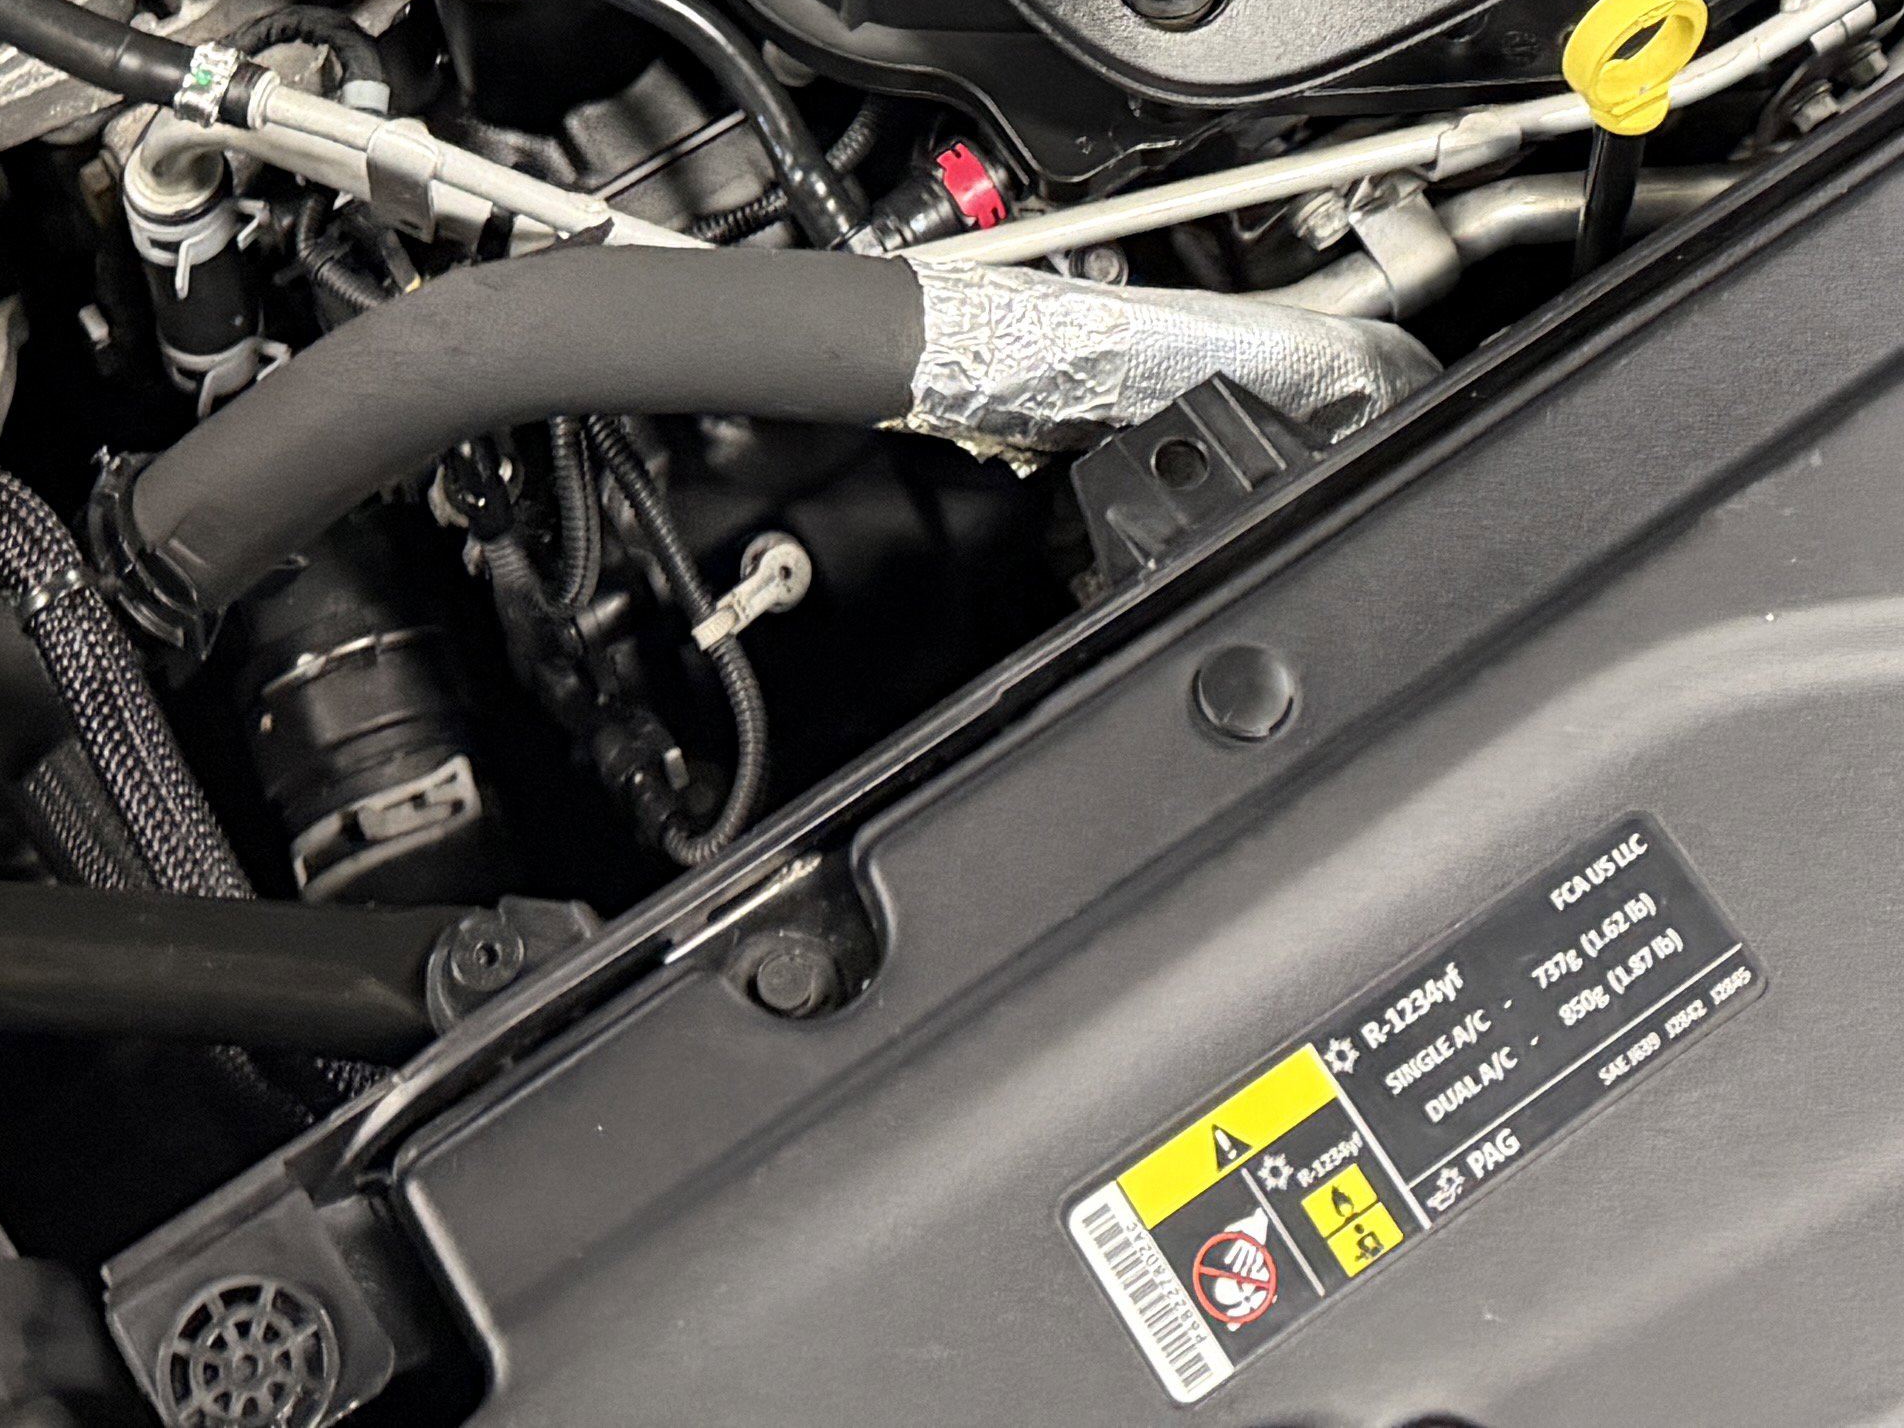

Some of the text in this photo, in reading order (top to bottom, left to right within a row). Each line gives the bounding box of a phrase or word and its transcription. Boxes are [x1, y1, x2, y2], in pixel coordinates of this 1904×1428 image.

[1549, 832, 1649, 912] FCA US LLC
[1360, 961, 1464, 1050] R-1234yf
[1384, 1033, 1456, 1096] SINGLE
[1451, 1008, 1492, 1050] A/C
[1531, 948, 1584, 990] 737g
[1579, 910, 1631, 958] (1.62
[1623, 891, 1657, 924] lb)
[1423, 1074, 1484, 1124] DUAL
[1478, 1045, 1519, 1087] A/C
[1558, 984, 1611, 1027] 850g
[1606, 945, 1654, 995] (1.87
[1649, 927, 1684, 960] lb)
[1598, 1053, 1633, 1087] SAE
[1465, 1126, 1522, 1180] PAG
